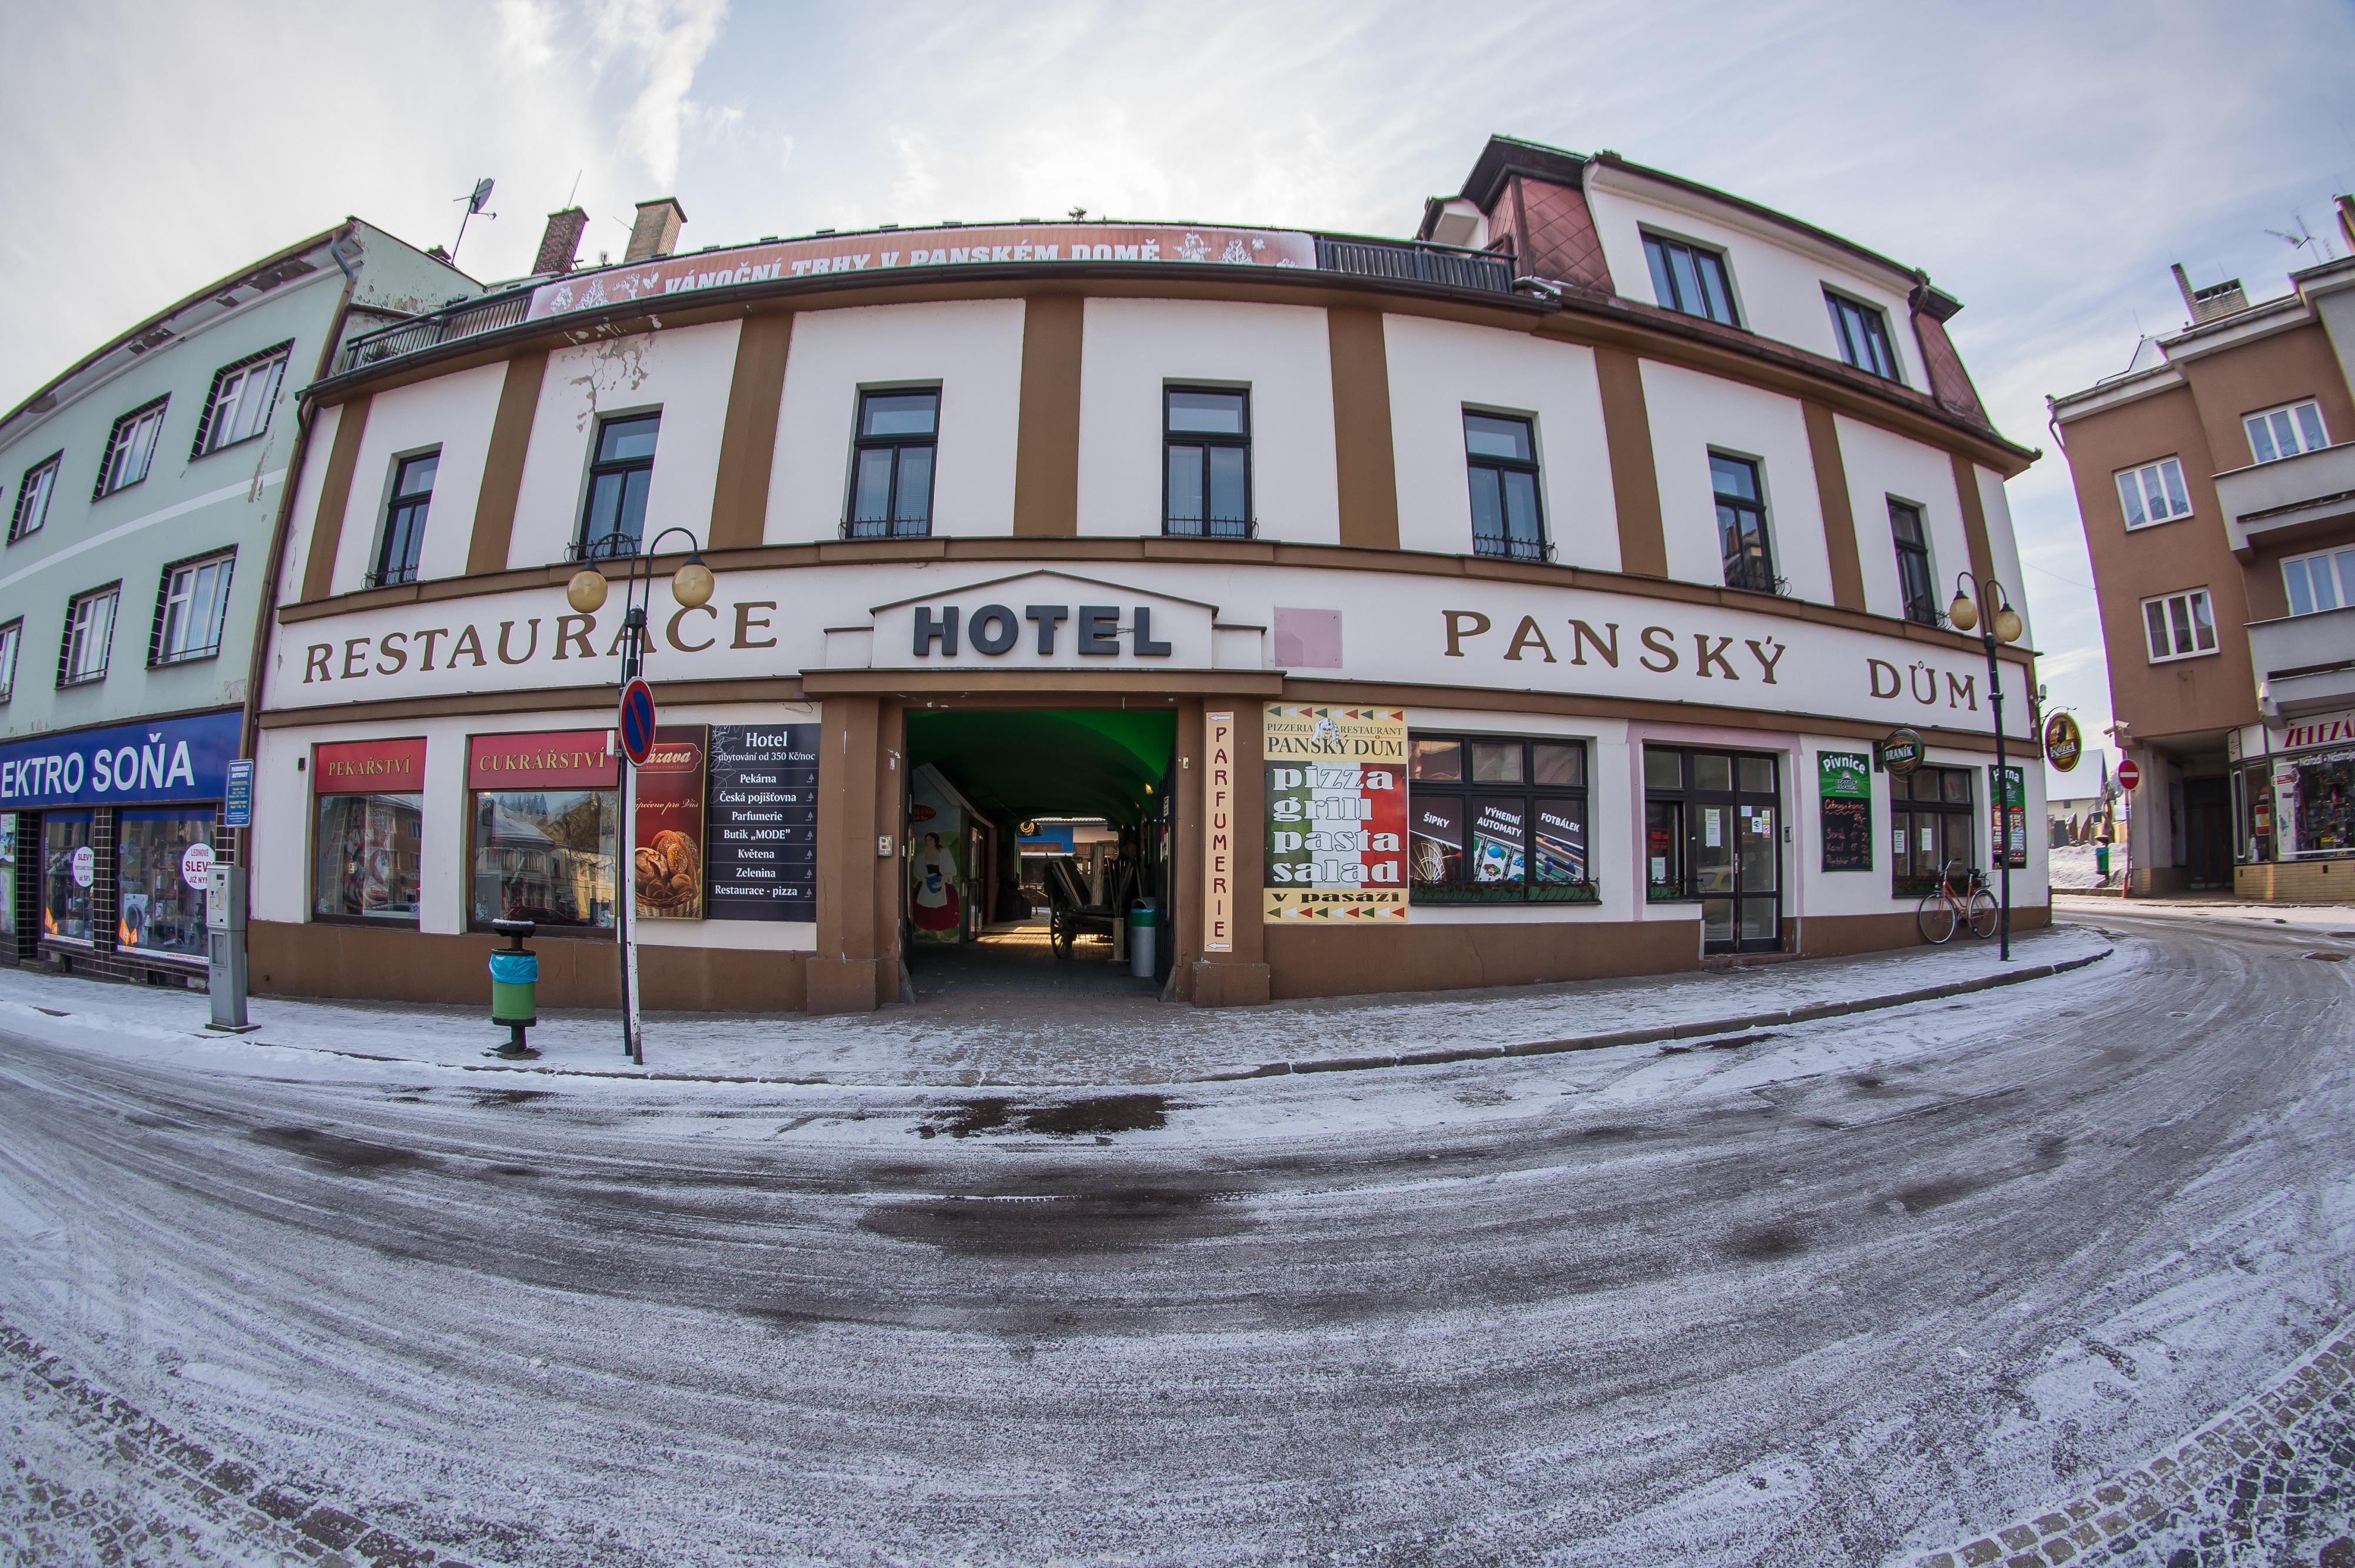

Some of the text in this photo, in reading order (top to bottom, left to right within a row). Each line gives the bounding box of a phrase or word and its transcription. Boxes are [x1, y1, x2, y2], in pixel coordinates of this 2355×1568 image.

[665, 238, 1160, 293] VÁNOČNÍ TRHY V PANSKÉM DOMĚ
[913, 604, 1172, 657] HOTEL
[303, 600, 778, 683] RESTAURACE
[1442, 609, 1978, 711] PANSKÝ DŮM
[1267, 723, 1403, 735] PIZZERIA RESTAURANT
[2284, 713, 2355, 748] ŽELEZÁ
[745, 732, 788, 748] Hotel
[1267, 735, 1404, 756] PANSKÝ DŮM
[646, 748, 691, 764] ázava
[718, 751, 815, 764] ubytování od 350 Kč/noc
[2050, 742, 2076, 758] Kozel
[92, 732, 195, 792] SOŇA
[329, 754, 411, 776] PEKAŘSTVÍ
[479, 748, 606, 772] CUKRÁŘSTVÍ
[1823, 755, 1866, 774] Pivnice
[739, 773, 777, 783] Pekárna
[1273, 766, 1394, 790] pizza
[1992, 769, 2020, 783] Hrna
[719, 790, 797, 804] Česká pojišťovna
[732, 810, 783, 821] Parfumerie
[1273, 796, 1373, 822] grill
[1485, 806, 1522, 825] VÝHERNÍ
[1423, 812, 1450, 828] ŠIPKY
[1477, 816, 1522, 838] AUTOMATY
[1541, 812, 1580, 833] FOTBÁLEK
[724, 829, 748, 839] Butik
[1213, 727, 1228, 938] PARFUMERIE
[1273, 829, 1400, 853] pasta
[738, 849, 775, 858] Květena
[185, 861, 215, 872] SLEV
[736, 868, 776, 878] Zelenina
[1272, 859, 1400, 883] salad
[715, 885, 765, 895] Restaurace
[772, 886, 798, 901] pizza
[1272, 892, 1400, 903] v pasáží
